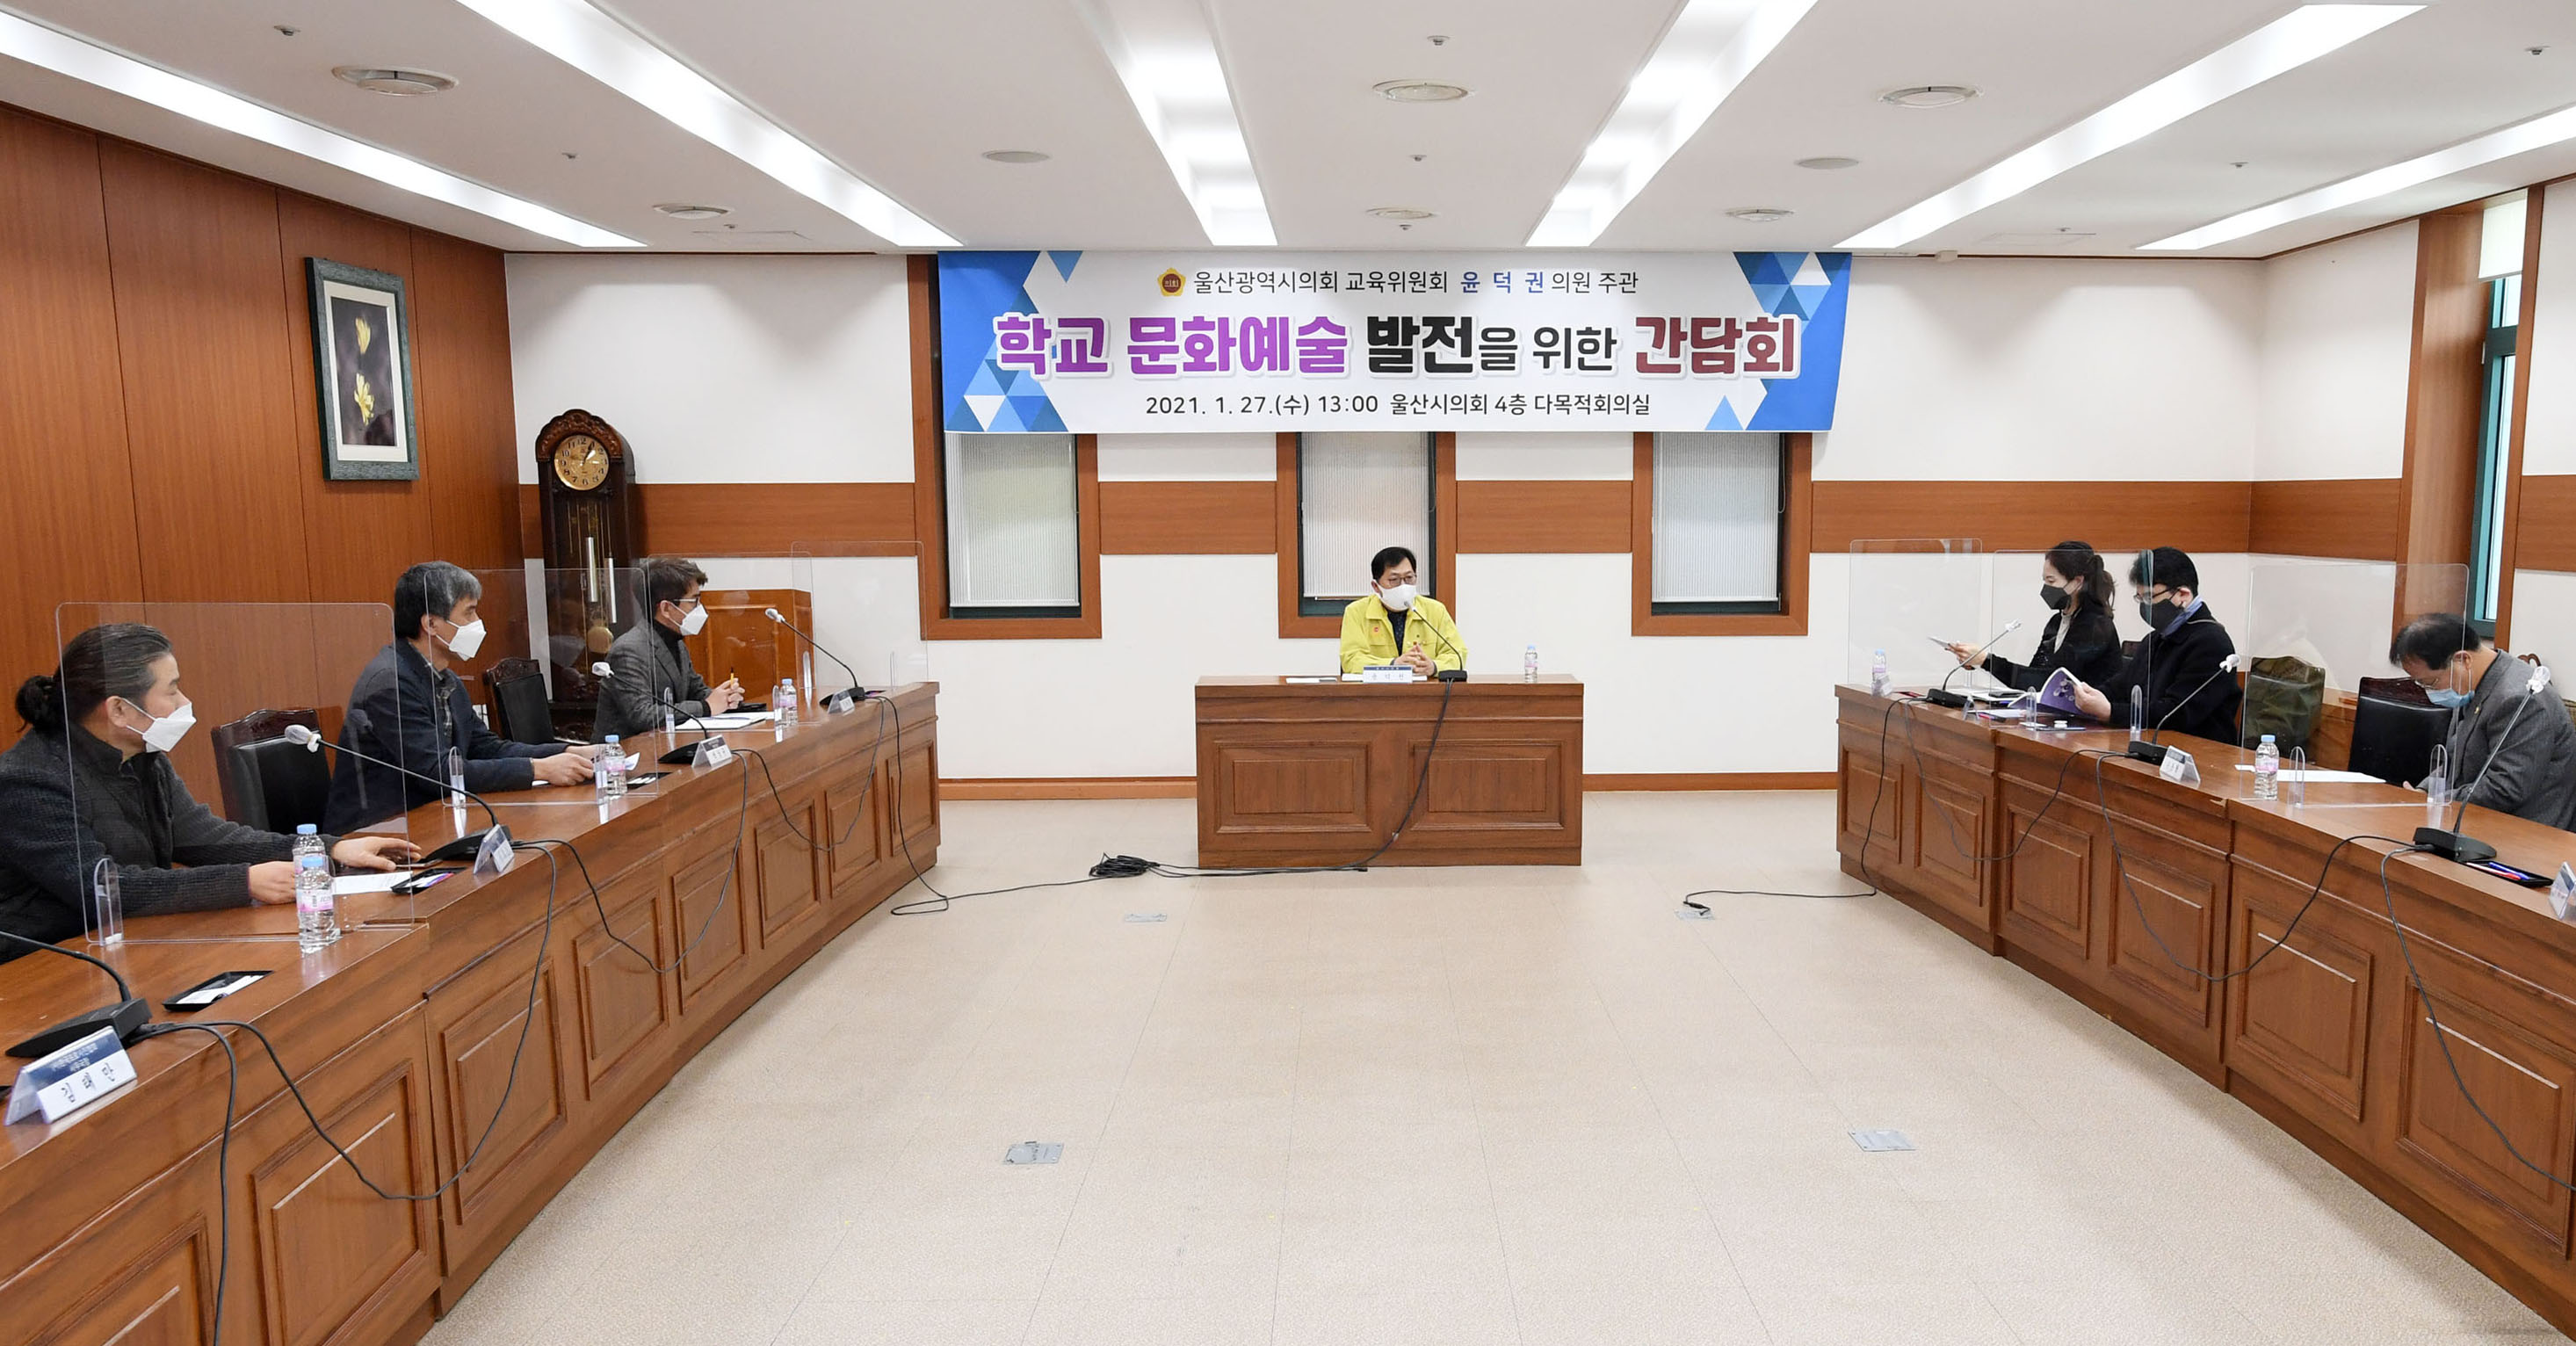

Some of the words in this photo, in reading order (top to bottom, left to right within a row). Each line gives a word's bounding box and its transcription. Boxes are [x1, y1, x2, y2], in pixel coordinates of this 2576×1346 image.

[1193, 271, 1338, 294] 울산광역시의회
[1344, 271, 1448, 294] 교육위원회
[1460, 271, 1481, 293] 윤
[1493, 271, 1511, 293] 덕
[1524, 271, 1543, 293] 권
[1552, 271, 1590, 293] 의원
[1598, 271, 1639, 294] 주관
[996, 316, 1109, 375] 학교
[1127, 316, 1348, 375] 문화예술
[1367, 316, 1518, 373] 발전을
[1533, 326, 1617, 372] 위한
[1635, 315, 1795, 374] 간담회
[1146, 396, 1206, 416] 2021.
[1215, 396, 1233, 415] 1.
[1240, 394, 1310, 416] 27.(수)
[1318, 394, 1378, 413] 13:00
[1389, 393, 1487, 416] 울산시의회
[1494, 393, 1528, 416] 4층
[1534, 393, 1650, 416] 다목적회의실
